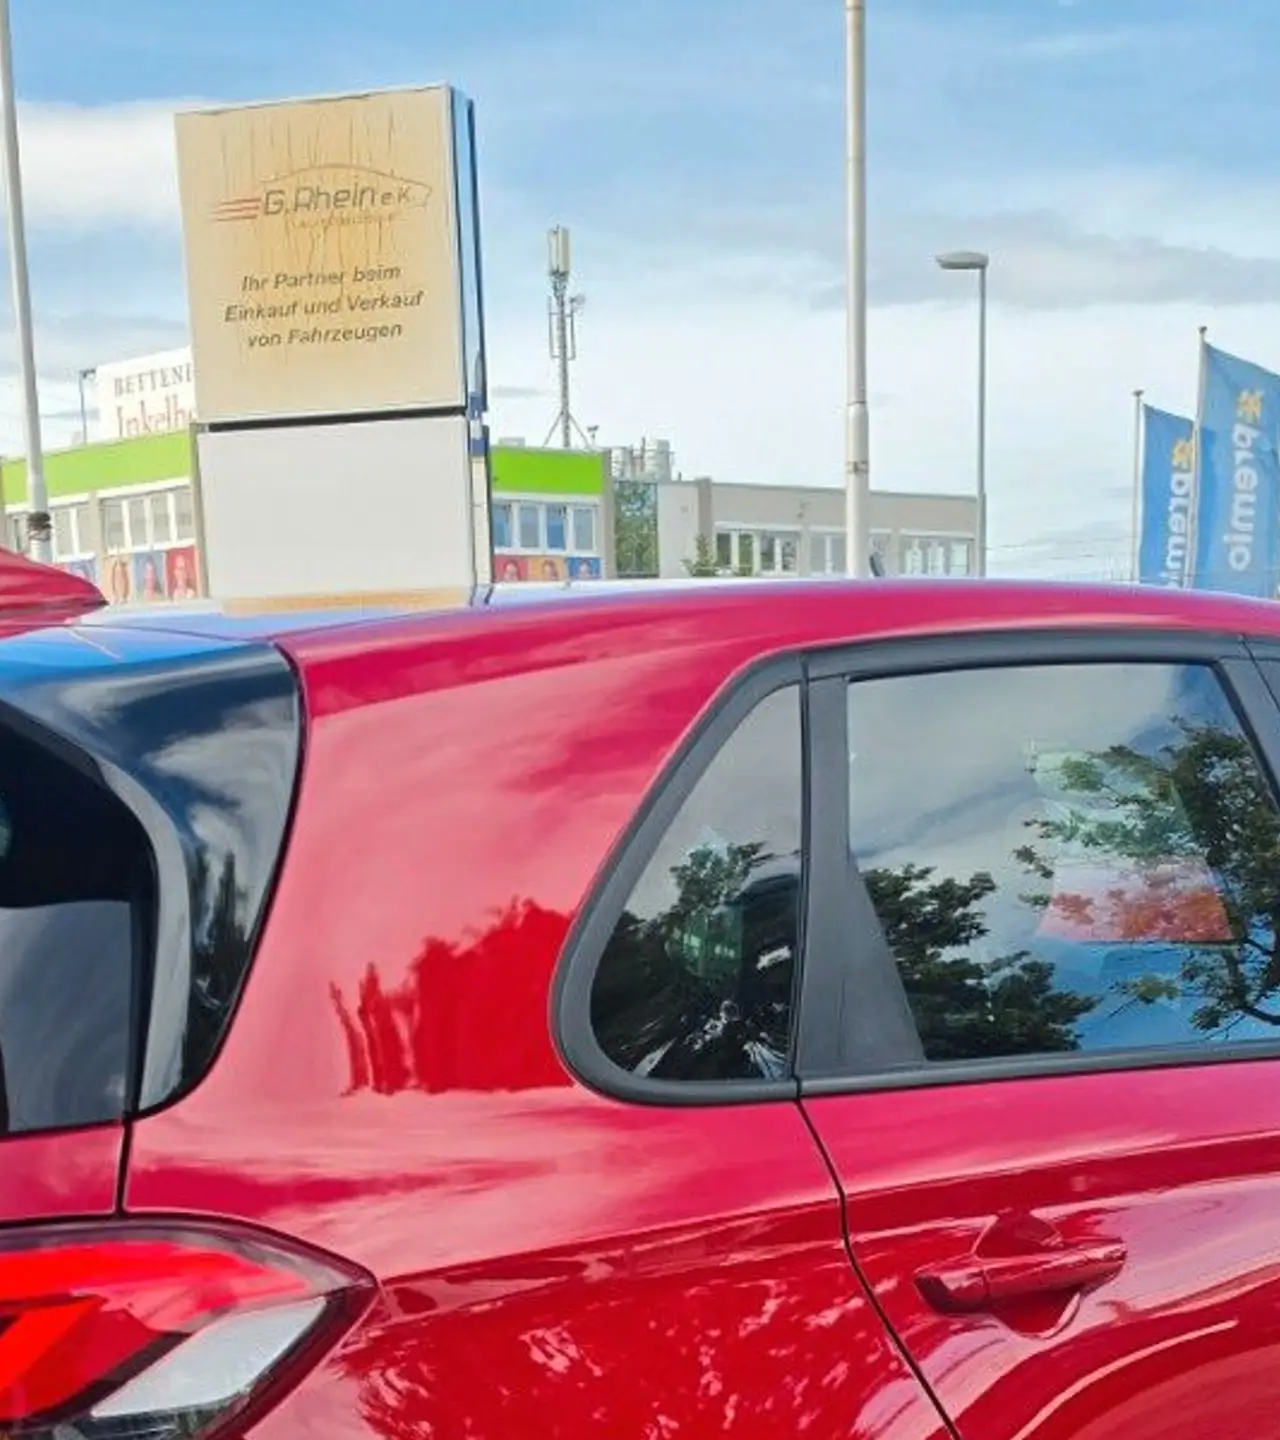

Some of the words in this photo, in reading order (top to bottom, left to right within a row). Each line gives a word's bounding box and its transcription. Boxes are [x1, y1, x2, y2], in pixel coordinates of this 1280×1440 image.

[241, 275, 269, 292] Ihr
[274, 271, 345, 290] Partner
[352, 265, 402, 283] beim
[224, 301, 299, 322] Einkauf
[304, 298, 341, 316] und
[347, 290, 425, 312] Verkauf
[248, 333, 282, 347] von
[287, 323, 403, 345] Fahrzeugen
